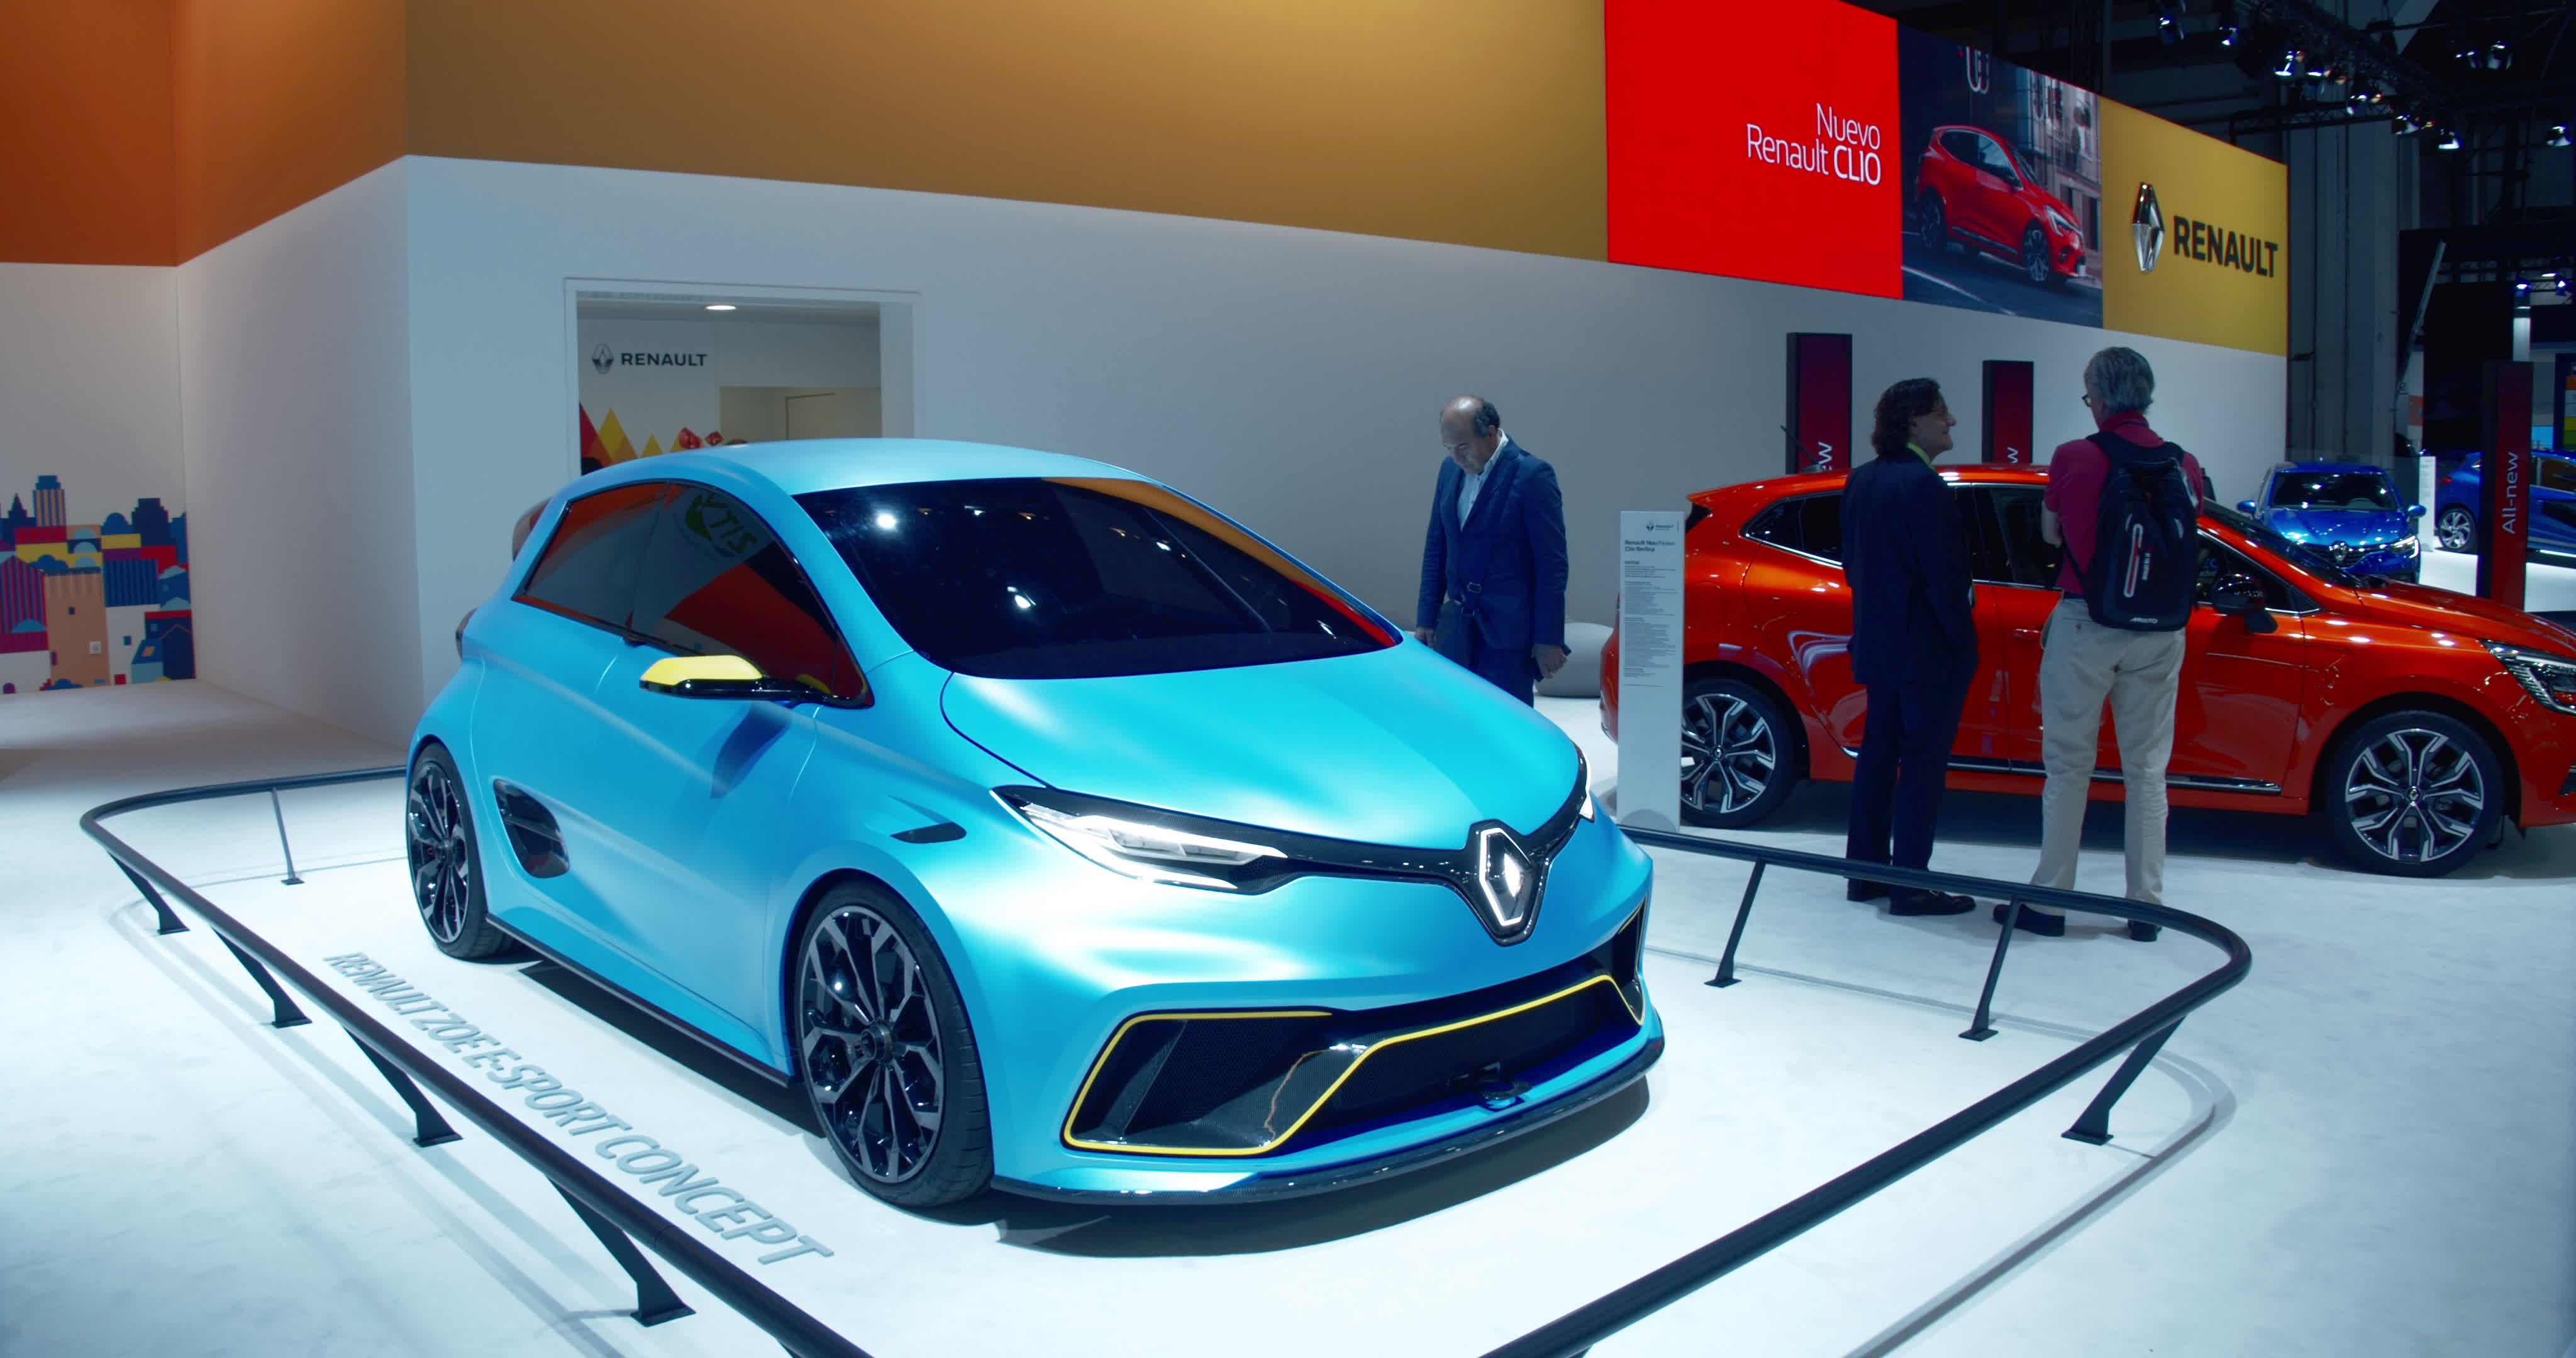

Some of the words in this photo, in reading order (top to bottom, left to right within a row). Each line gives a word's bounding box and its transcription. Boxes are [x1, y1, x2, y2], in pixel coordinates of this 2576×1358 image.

[1746, 123, 1829, 175] Renault
[1833, 145, 1882, 186] CLIO
[1816, 102, 1880, 150] Nuevo
[2173, 214, 2279, 278] RENAULT
[621, 352, 708, 367] RENAULT
[2501, 451, 2519, 534] All-new
[323, 951, 449, 1016] RENAULT
[409, 1012, 502, 1054] ZOE
[595, 1134, 835, 1266] CONCEPT
